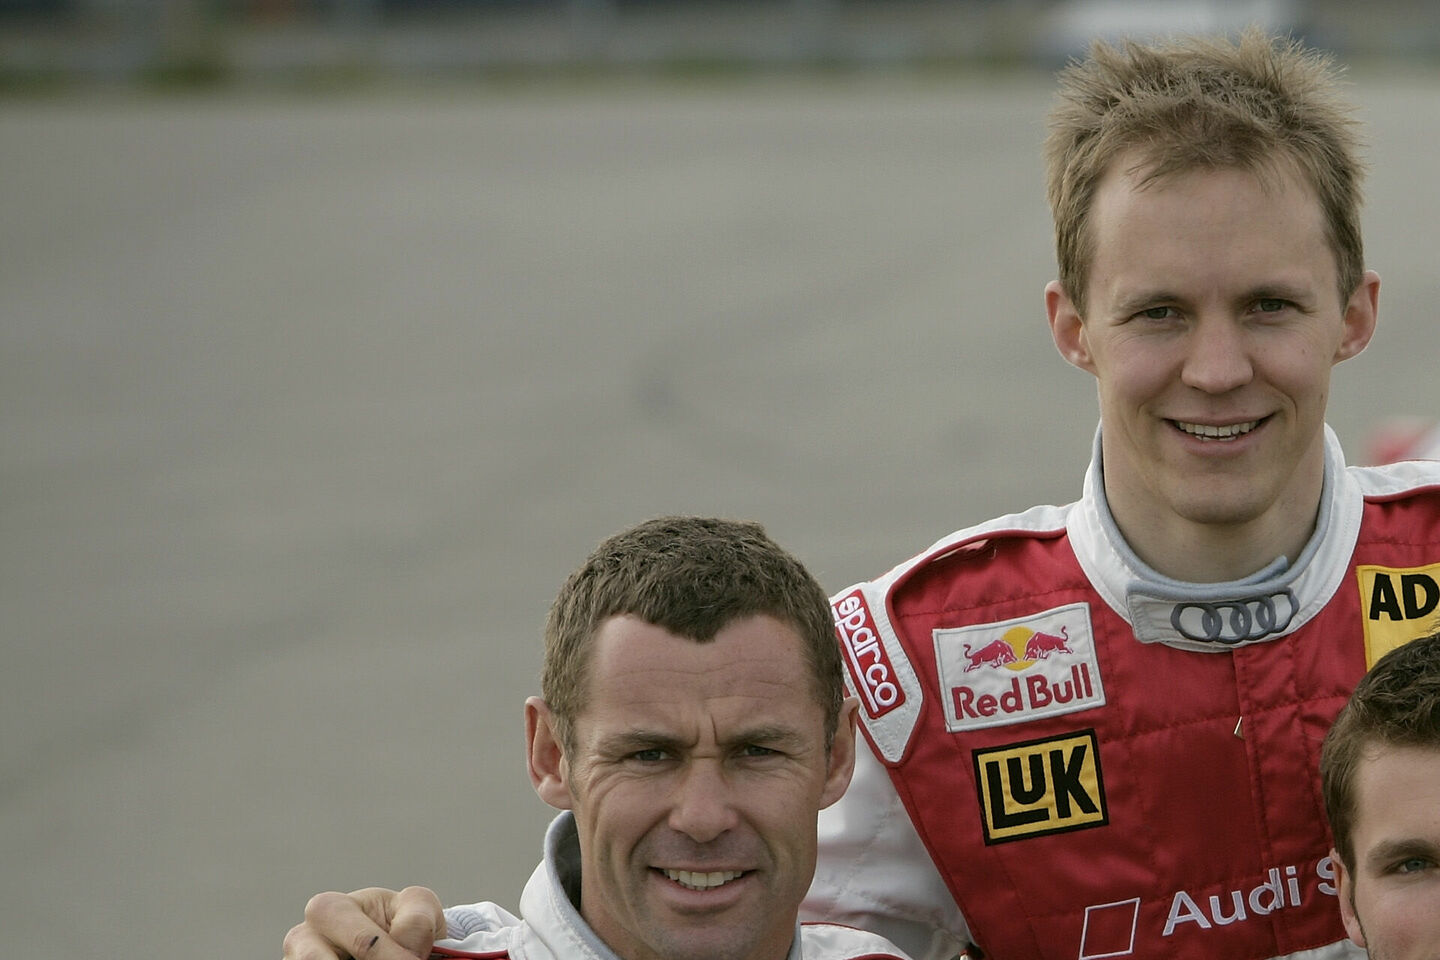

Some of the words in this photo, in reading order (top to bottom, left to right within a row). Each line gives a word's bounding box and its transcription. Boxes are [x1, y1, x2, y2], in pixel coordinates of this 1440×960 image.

[835, 596, 898, 707] sparco
[951, 681, 1024, 720] Red
[1026, 664, 1093, 709] Bull
[1162, 865, 1302, 937] Audi
